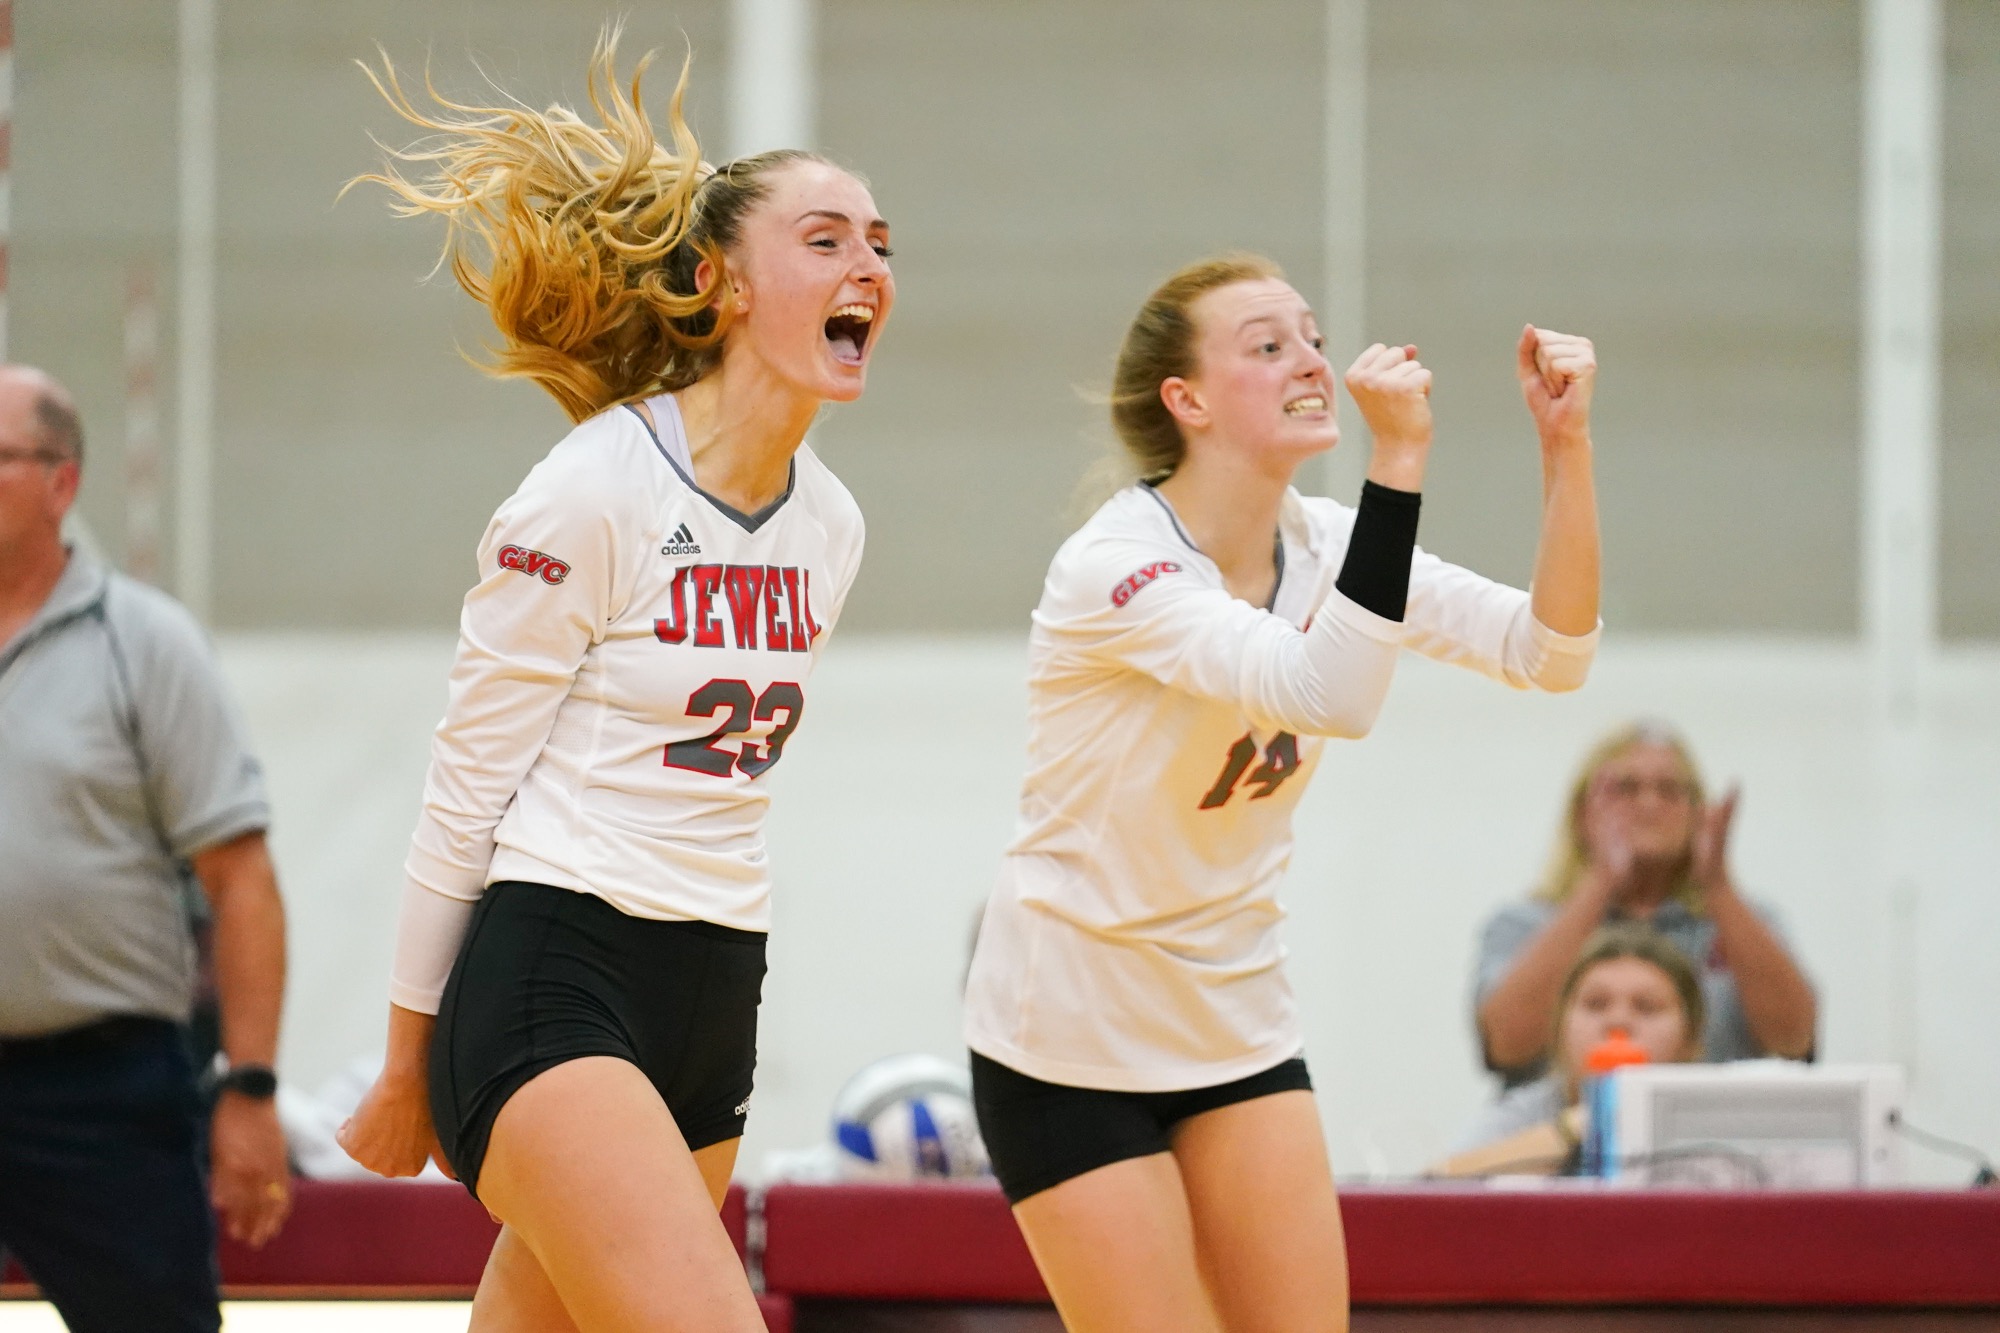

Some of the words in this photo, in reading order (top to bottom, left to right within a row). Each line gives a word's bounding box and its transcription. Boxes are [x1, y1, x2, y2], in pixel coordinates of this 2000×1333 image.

[497, 544, 571, 585] GLVC
[661, 541, 702, 556] adidas
[1110, 561, 1183, 608] GLVC
[662, 678, 804, 780] 23
[1197, 729, 1302, 811] 14
